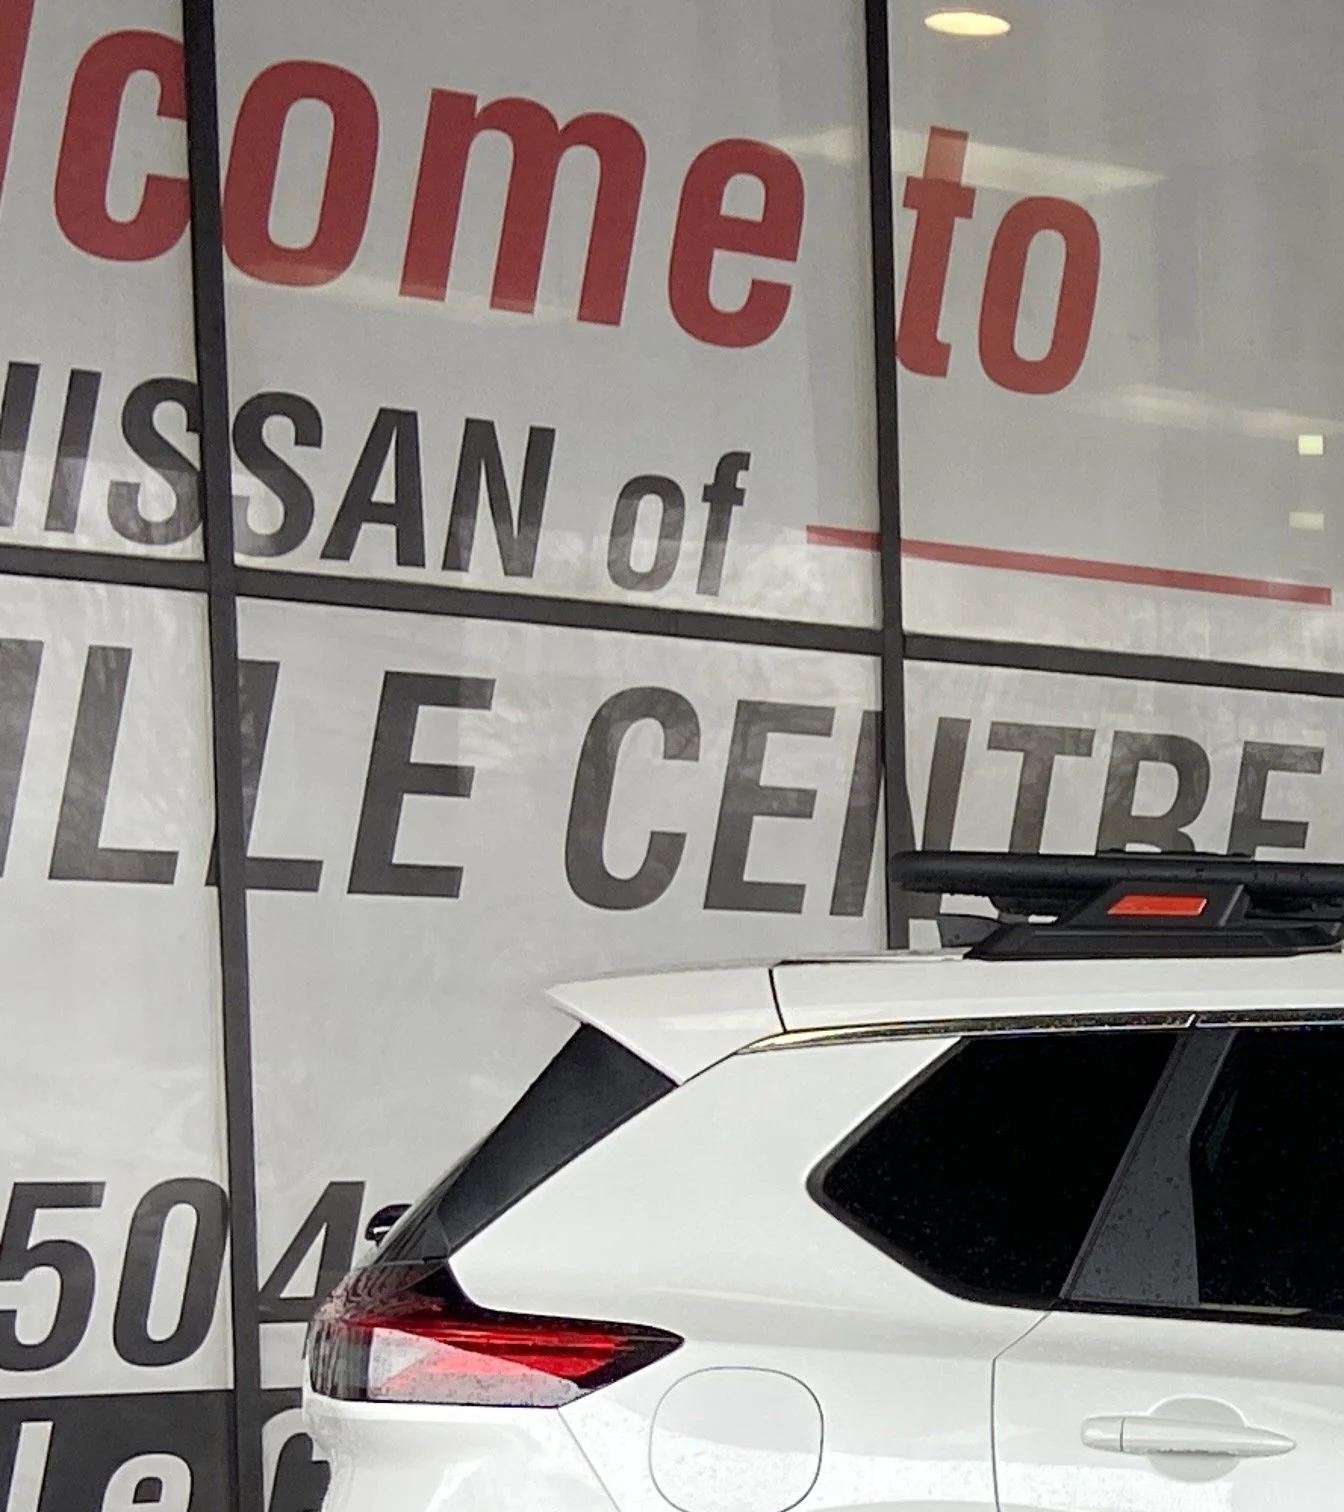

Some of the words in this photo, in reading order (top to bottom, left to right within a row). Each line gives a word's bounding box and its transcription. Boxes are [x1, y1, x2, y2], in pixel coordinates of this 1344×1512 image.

[0, 0, 804, 349] come
[896, 126, 1100, 395] to
[0, 361, 556, 578] ISSAN
[606, 451, 751, 596] of
